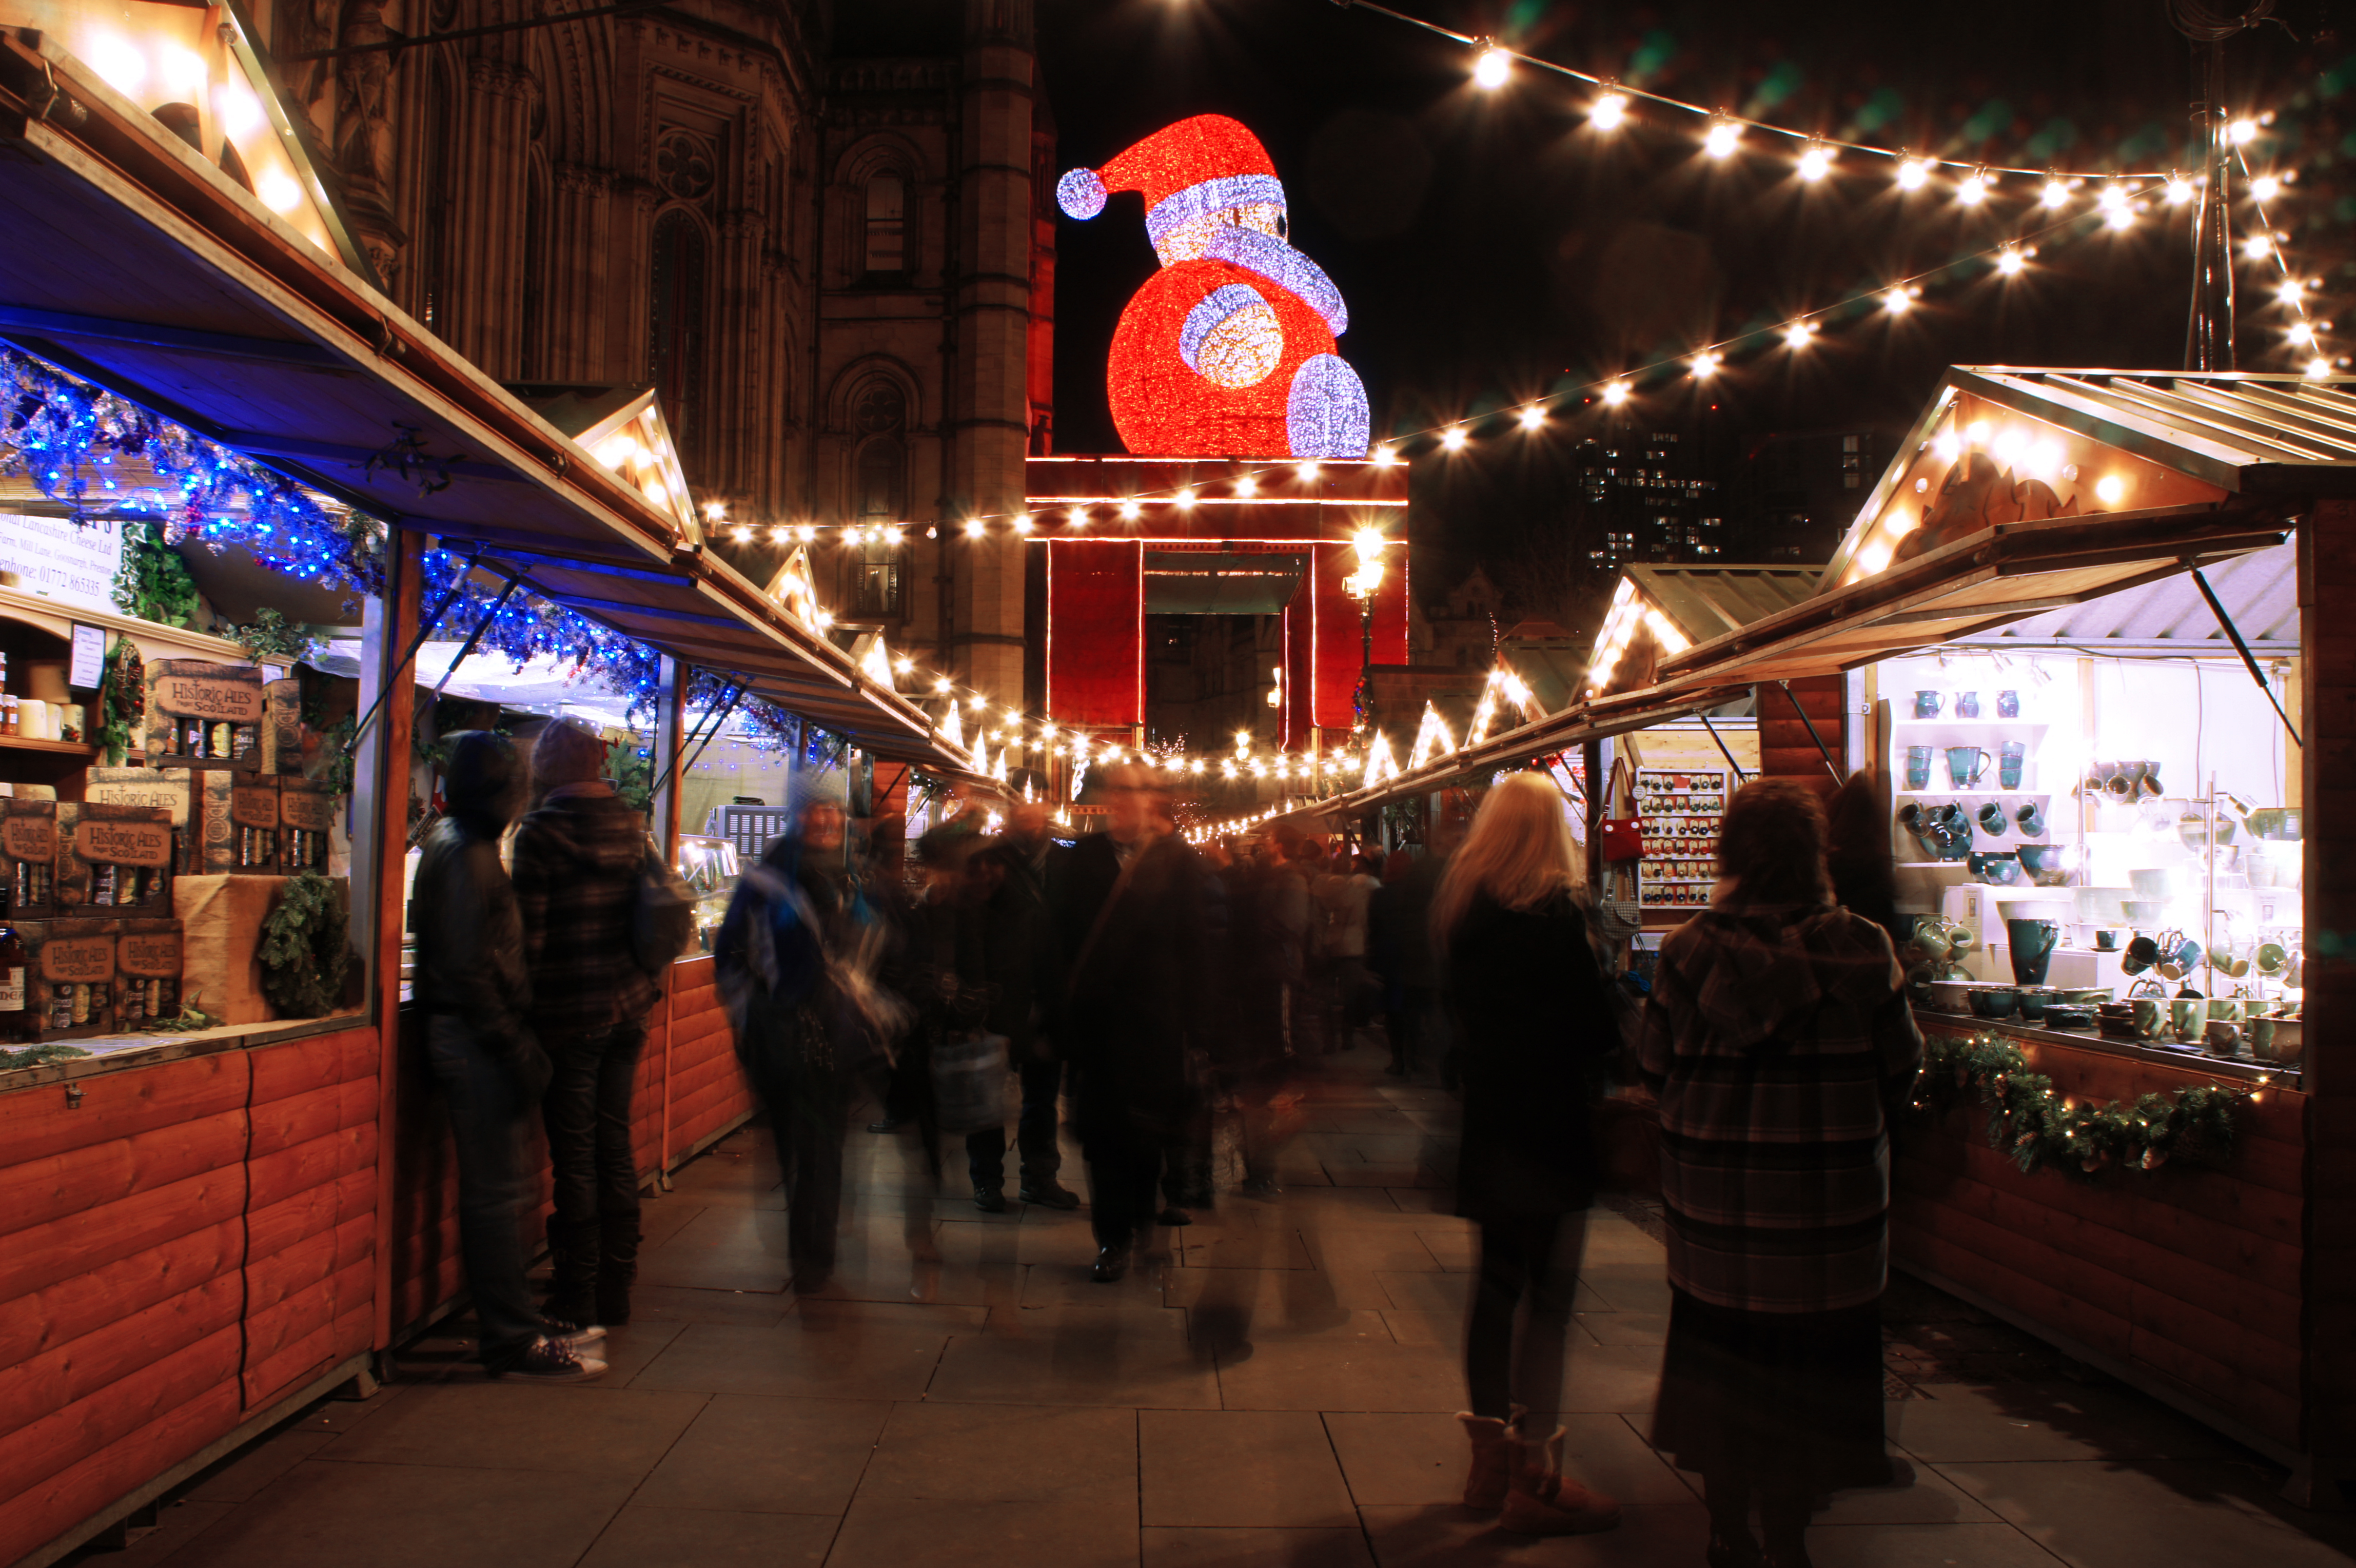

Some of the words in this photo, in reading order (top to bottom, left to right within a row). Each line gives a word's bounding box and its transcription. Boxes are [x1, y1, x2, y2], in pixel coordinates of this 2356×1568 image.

[0, 513, 20, 526] onal
[23, 515, 68, 541] Lancashire
[70, 531, 96, 551] Cheese
[99, 539, 112, 555] Ltd
[19, 538, 33, 553] Mill
[40, 565, 67, 587] 01772
[69, 574, 100, 596] 865335
